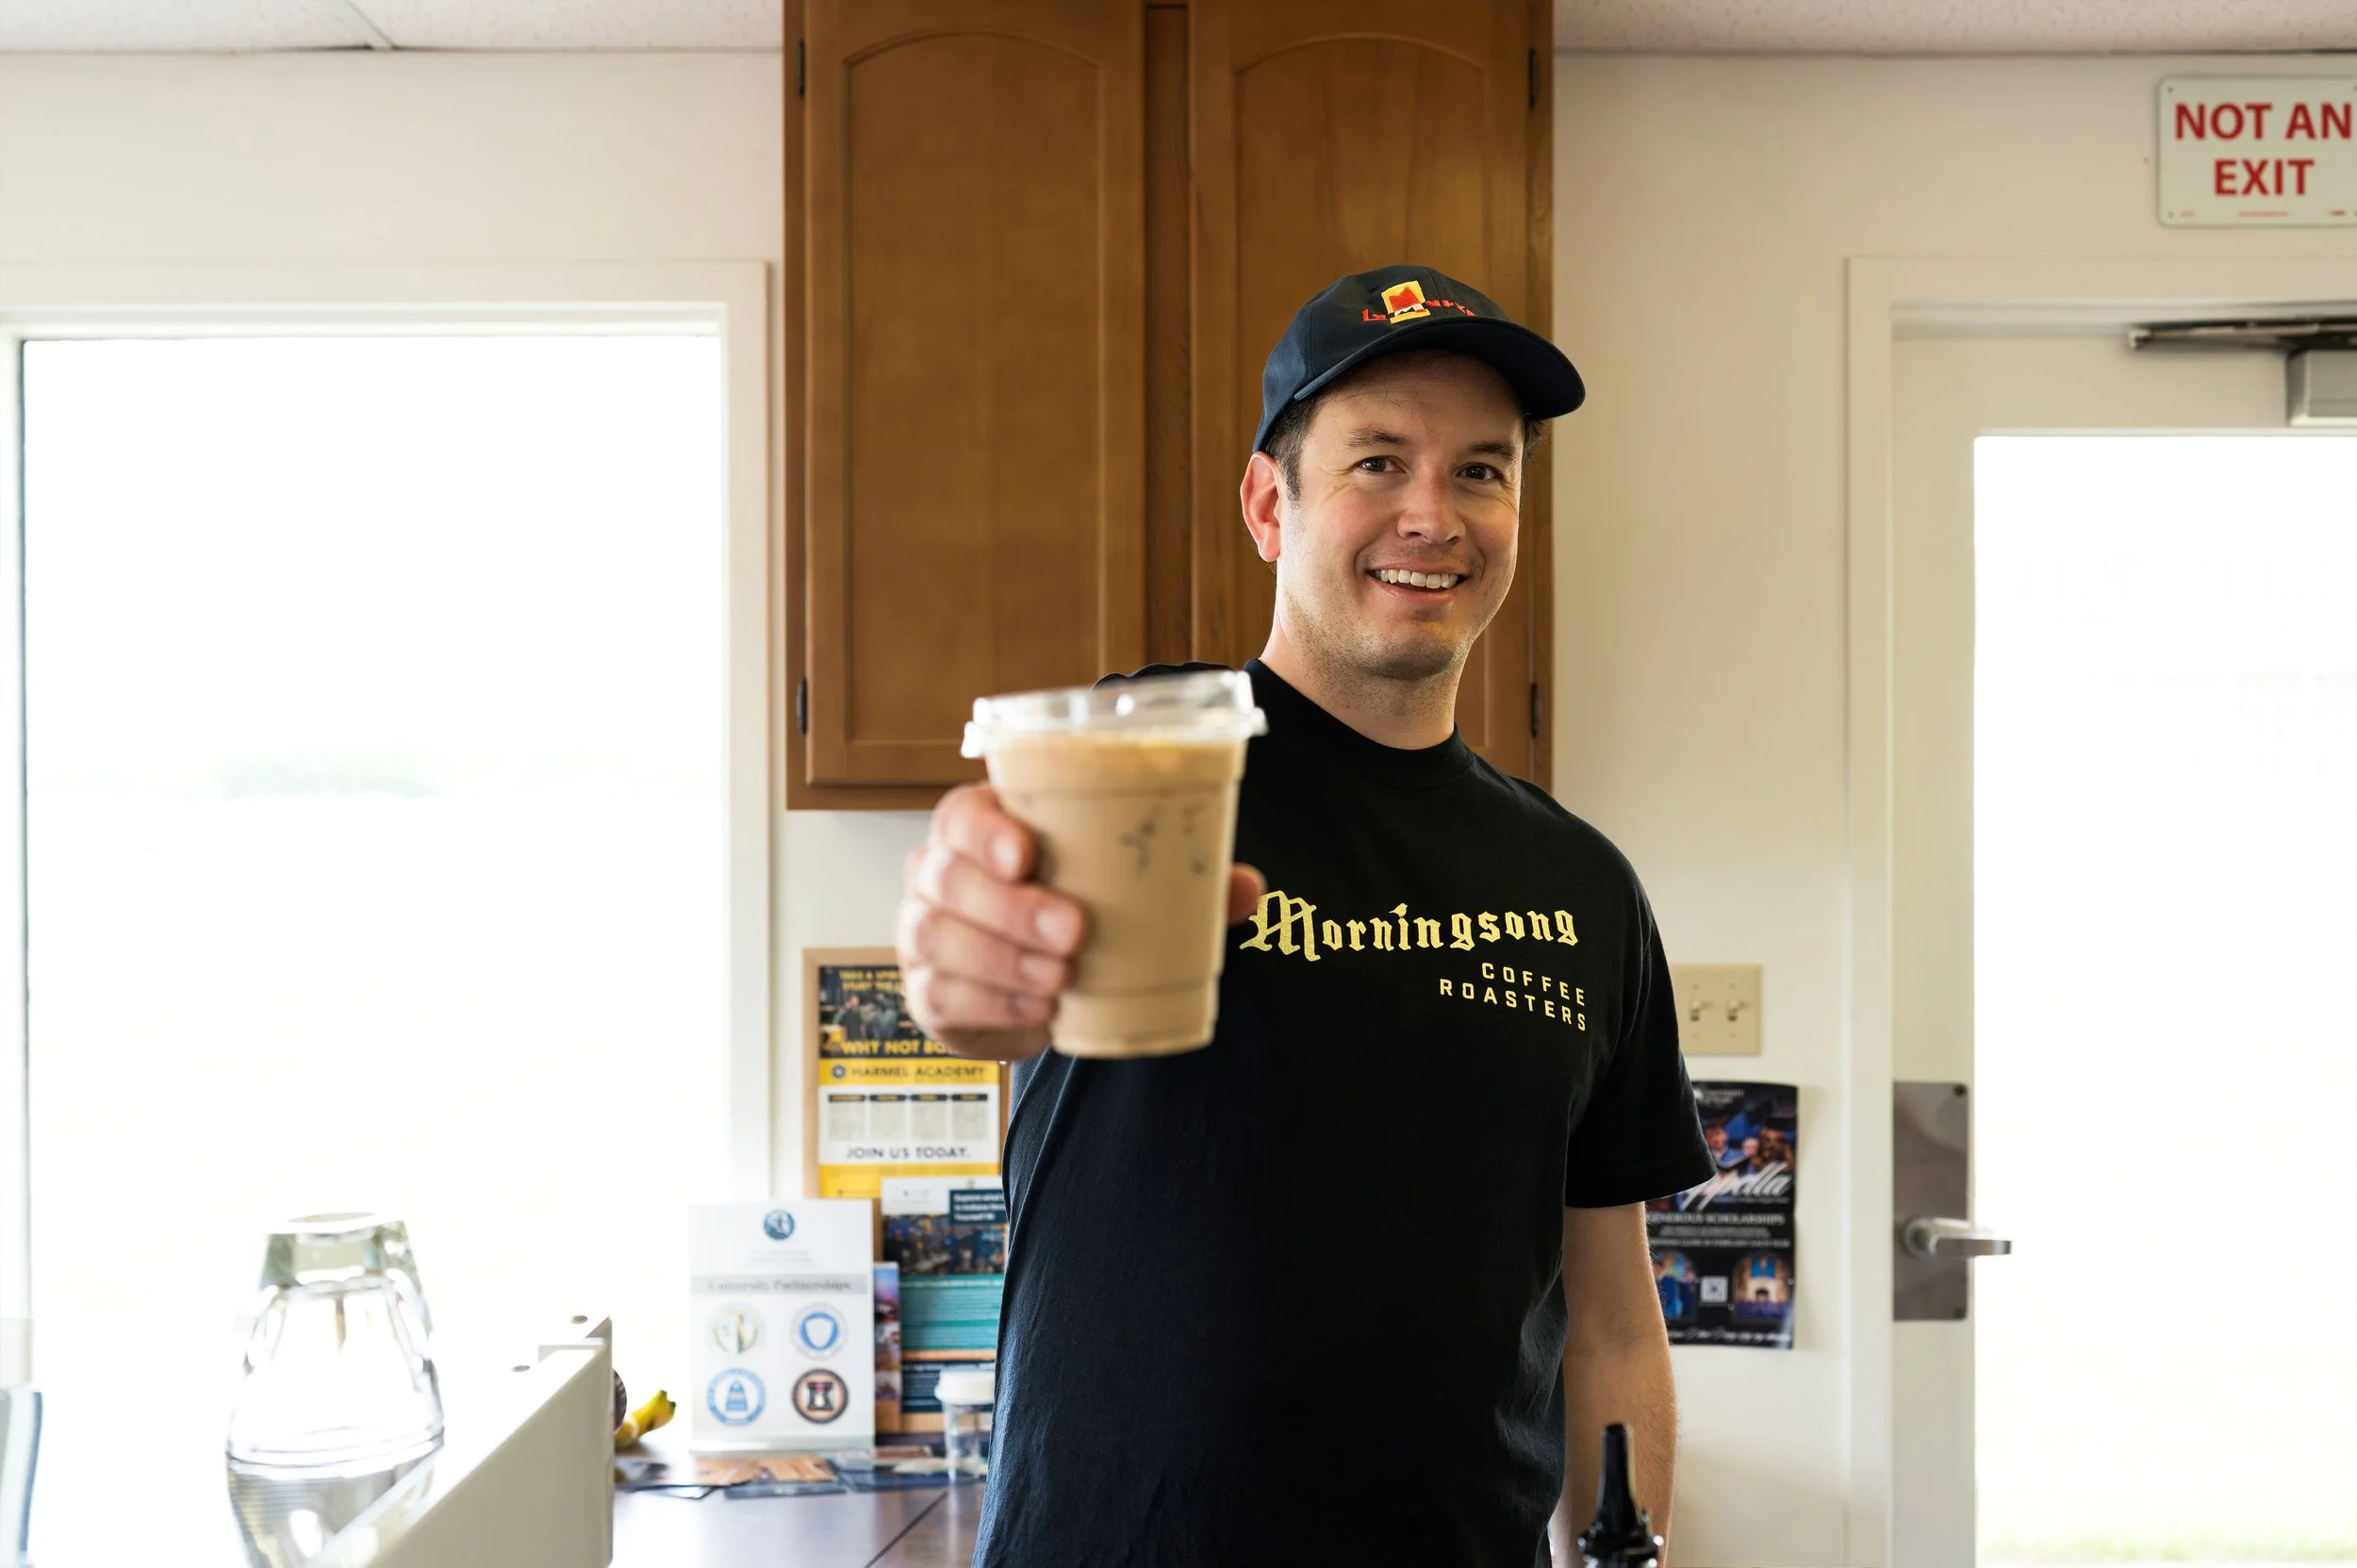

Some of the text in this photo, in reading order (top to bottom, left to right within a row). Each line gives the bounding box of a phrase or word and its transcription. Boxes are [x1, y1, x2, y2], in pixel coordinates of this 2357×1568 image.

[2175, 103, 2352, 140] NOT AN
[2214, 158, 2315, 196] EXIT
[1240, 890, 1579, 962] Morningsong
[1481, 962, 1586, 1007] COFFEE
[1440, 978, 1586, 1032] ROASTERS
[842, 1040, 880, 1054] WHY
[884, 1040, 920, 1055] NOT
[915, 1065, 984, 1077] ACADEMY
[847, 1147, 882, 1159] JOIN
[889, 1147, 909, 1159] US
